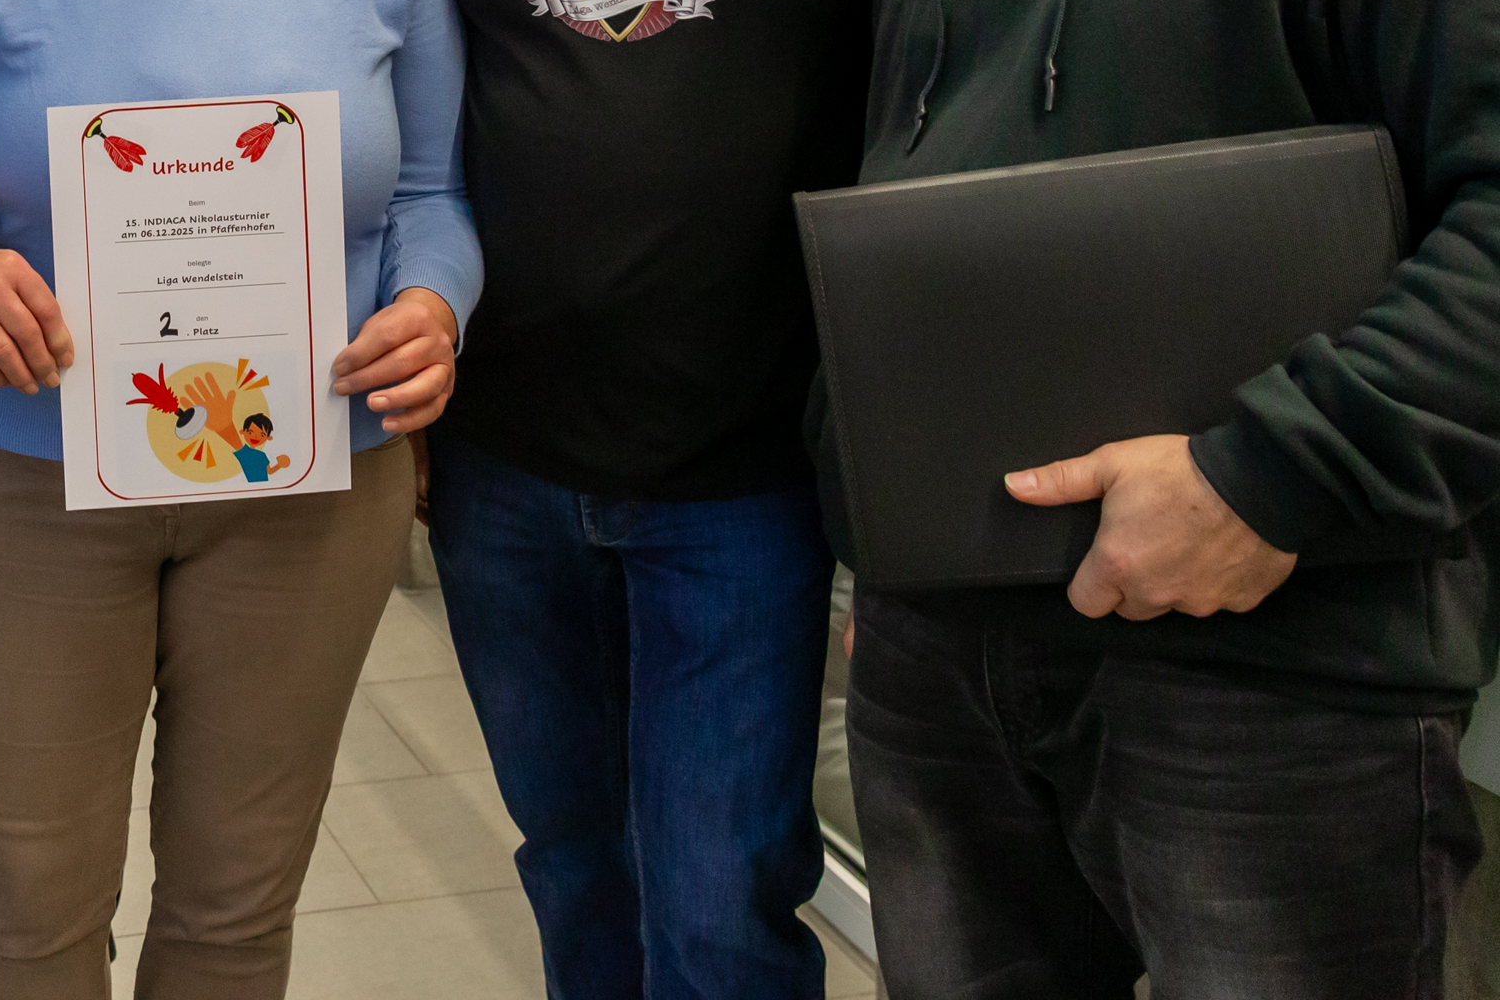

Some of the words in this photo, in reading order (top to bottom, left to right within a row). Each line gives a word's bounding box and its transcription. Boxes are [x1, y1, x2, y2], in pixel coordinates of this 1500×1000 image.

[152, 157, 235, 175] Urkunde
[125, 218, 141, 228] 15.
[144, 216, 186, 226] INDIACA
[189, 211, 271, 224] Nikolausturnier
[121, 231, 137, 239] am
[140, 227, 194, 238] 06.12.2025
[197, 226, 207, 234] in
[210, 223, 275, 234] Pfaffenhofen
[187, 260, 212, 268] belegte
[157, 276, 179, 287] Liga
[181, 272, 244, 284] Wendelstein
[159, 311, 179, 338] 2
[193, 327, 219, 336] Platz
